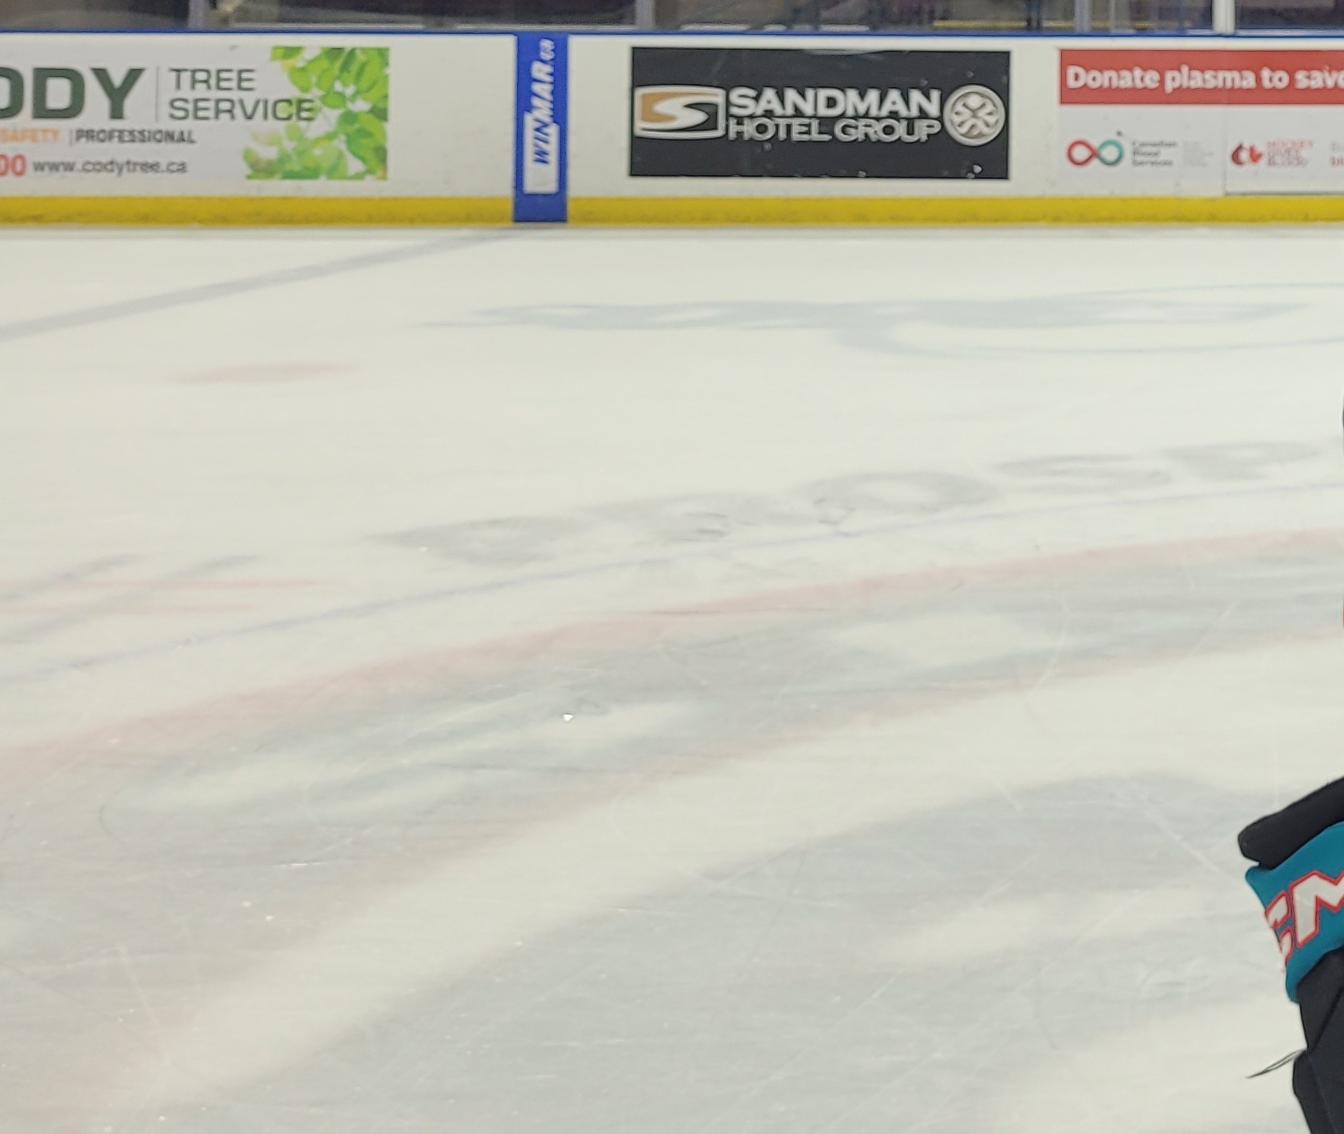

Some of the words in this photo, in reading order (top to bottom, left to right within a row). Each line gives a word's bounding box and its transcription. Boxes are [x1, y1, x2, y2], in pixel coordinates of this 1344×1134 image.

[170, 67, 255, 92] TREE
[1065, 65, 1160, 90] Donate
[1164, 65, 1257, 94] plasma
[1260, 67, 1291, 90] to
[168, 97, 316, 122] SERVICE
[728, 86, 942, 118] SANDMAN
[75, 128, 197, 145] PROFESSIONAL
[728, 118, 832, 142] HOTEL
[834, 118, 942, 143] GROUP
[32, 159, 188, 178] www.codytree.ca
